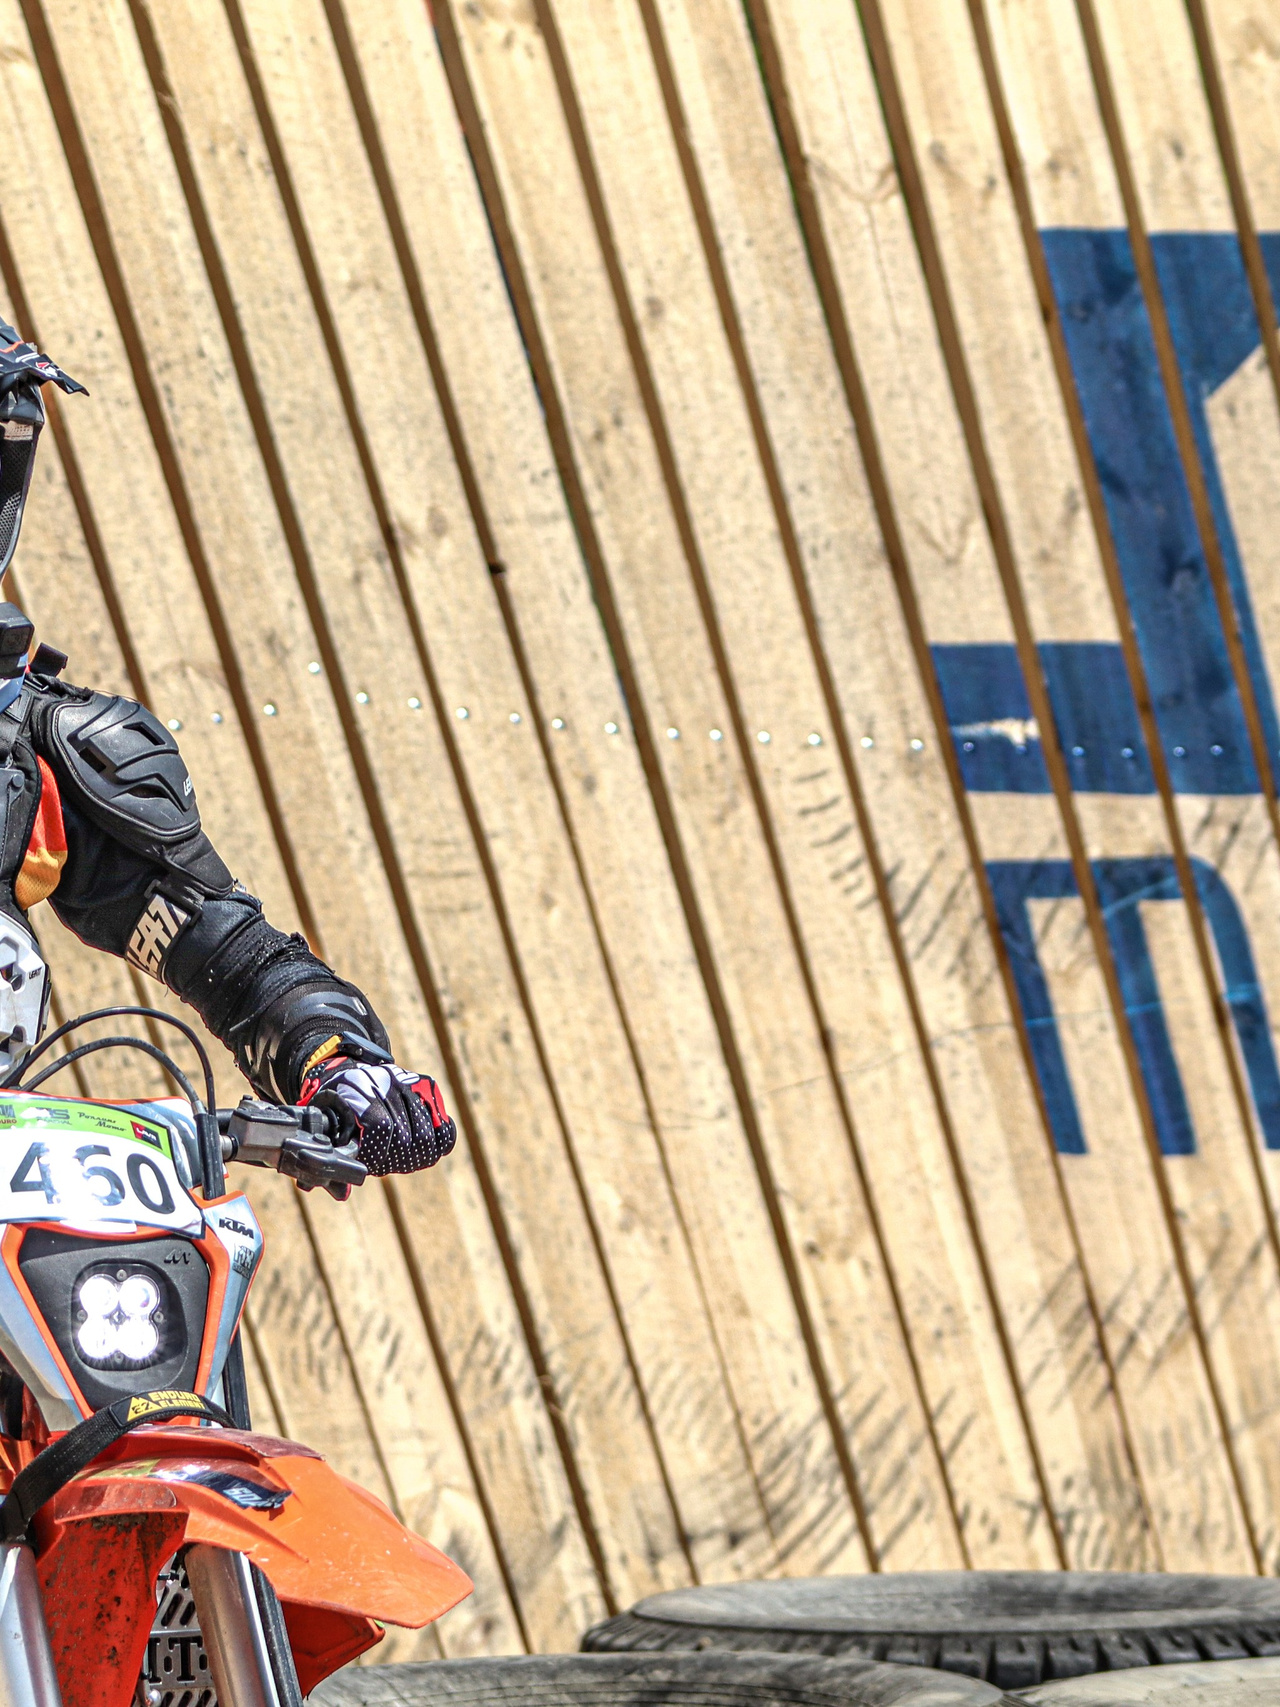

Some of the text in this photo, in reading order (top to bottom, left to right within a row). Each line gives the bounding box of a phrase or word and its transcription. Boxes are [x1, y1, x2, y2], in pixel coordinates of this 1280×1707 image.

[9, 1142, 176, 1215] 460
[219, 1217, 255, 1239] KTM
[148, 1390, 201, 1402] ENDURO
